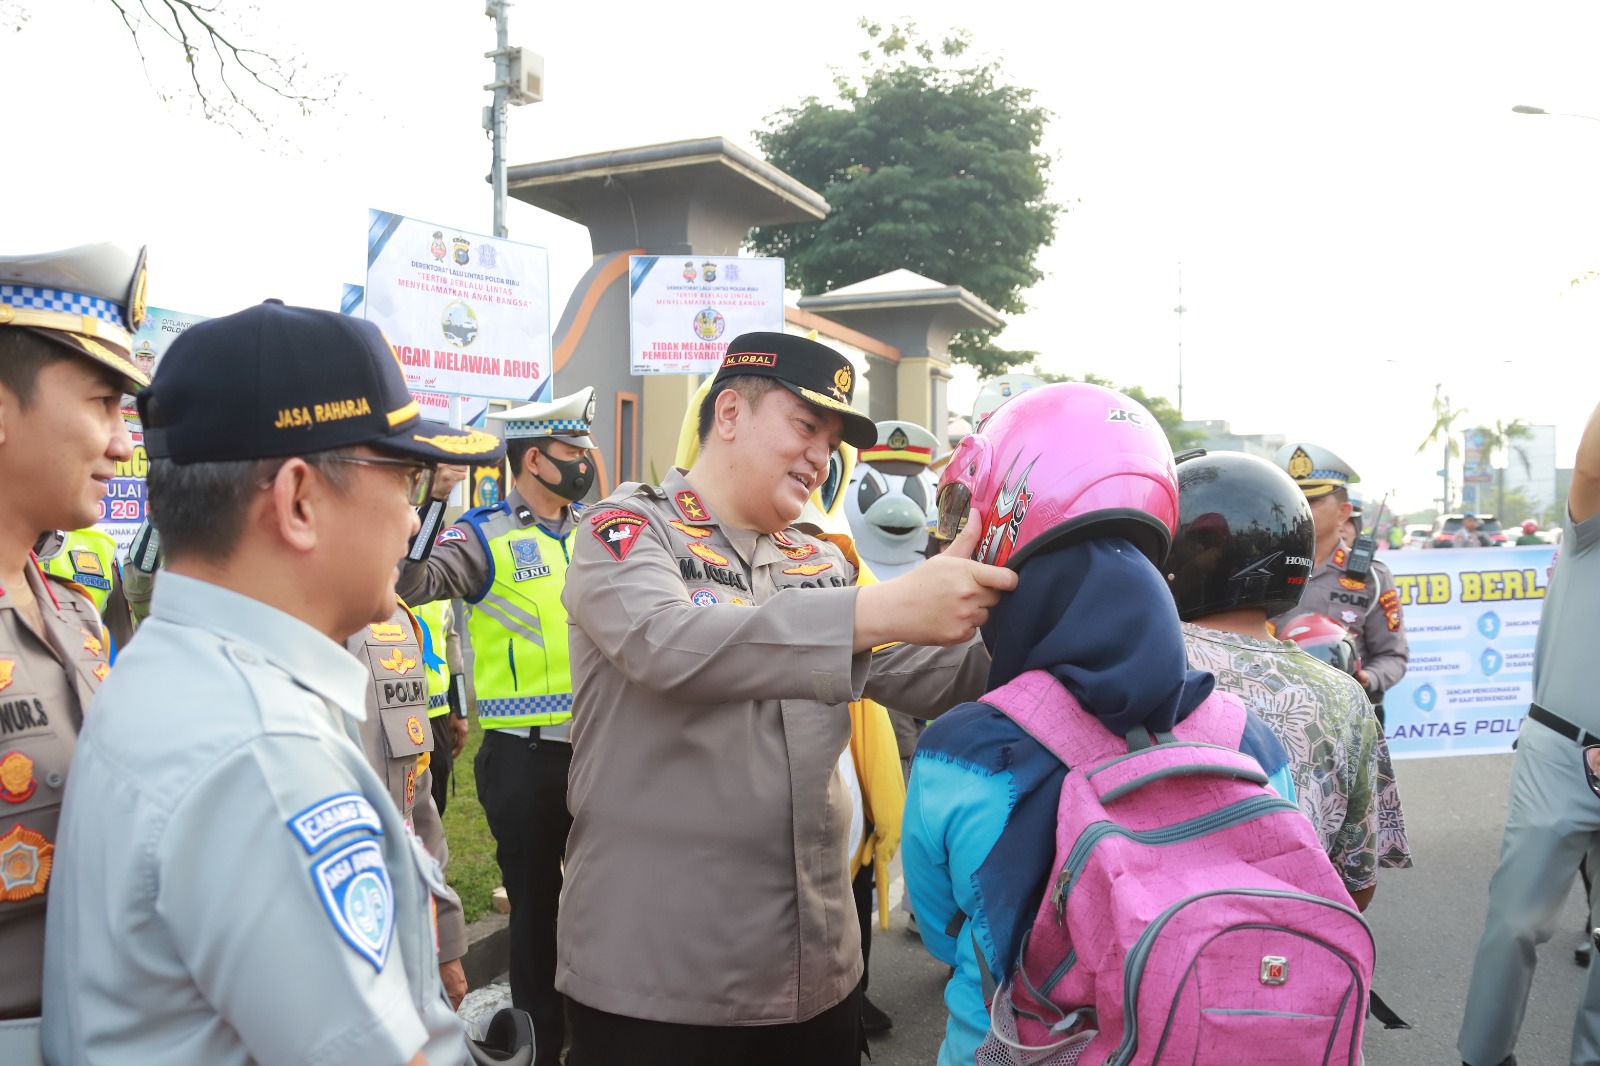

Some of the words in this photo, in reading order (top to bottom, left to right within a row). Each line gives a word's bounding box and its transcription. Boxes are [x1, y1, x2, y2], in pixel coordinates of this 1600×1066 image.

[449, 268, 464, 278] LALU
[464, 271, 485, 282] LINTAS
[398, 278, 469, 299] MENYELAMATKAN
[471, 291, 494, 304] ANAK
[486, 285, 513, 296] LINTAS
[652, 342, 679, 351] TIDAK
[642, 351, 681, 360] PEMBERI
[684, 351, 719, 360] ISYARAT
[726, 356, 736, 365] M.
[738, 355, 771, 364] IQBAL
[434, 350, 501, 376] MELAWAN
[503, 359, 540, 380] ARUS
[274, 406, 313, 428] JASA
[314, 396, 372, 422] RAHARJA
[112, 501, 139, 519] 20
[515, 566, 549, 580] IBNU
[680, 558, 702, 579] M.
[703, 562, 748, 591] IQBAL
[1330, 591, 1370, 608] POLRI
[1487, 655, 1497, 668] 7
[384, 681, 425, 704] POLRI
[1271, 965, 1280, 976] K
